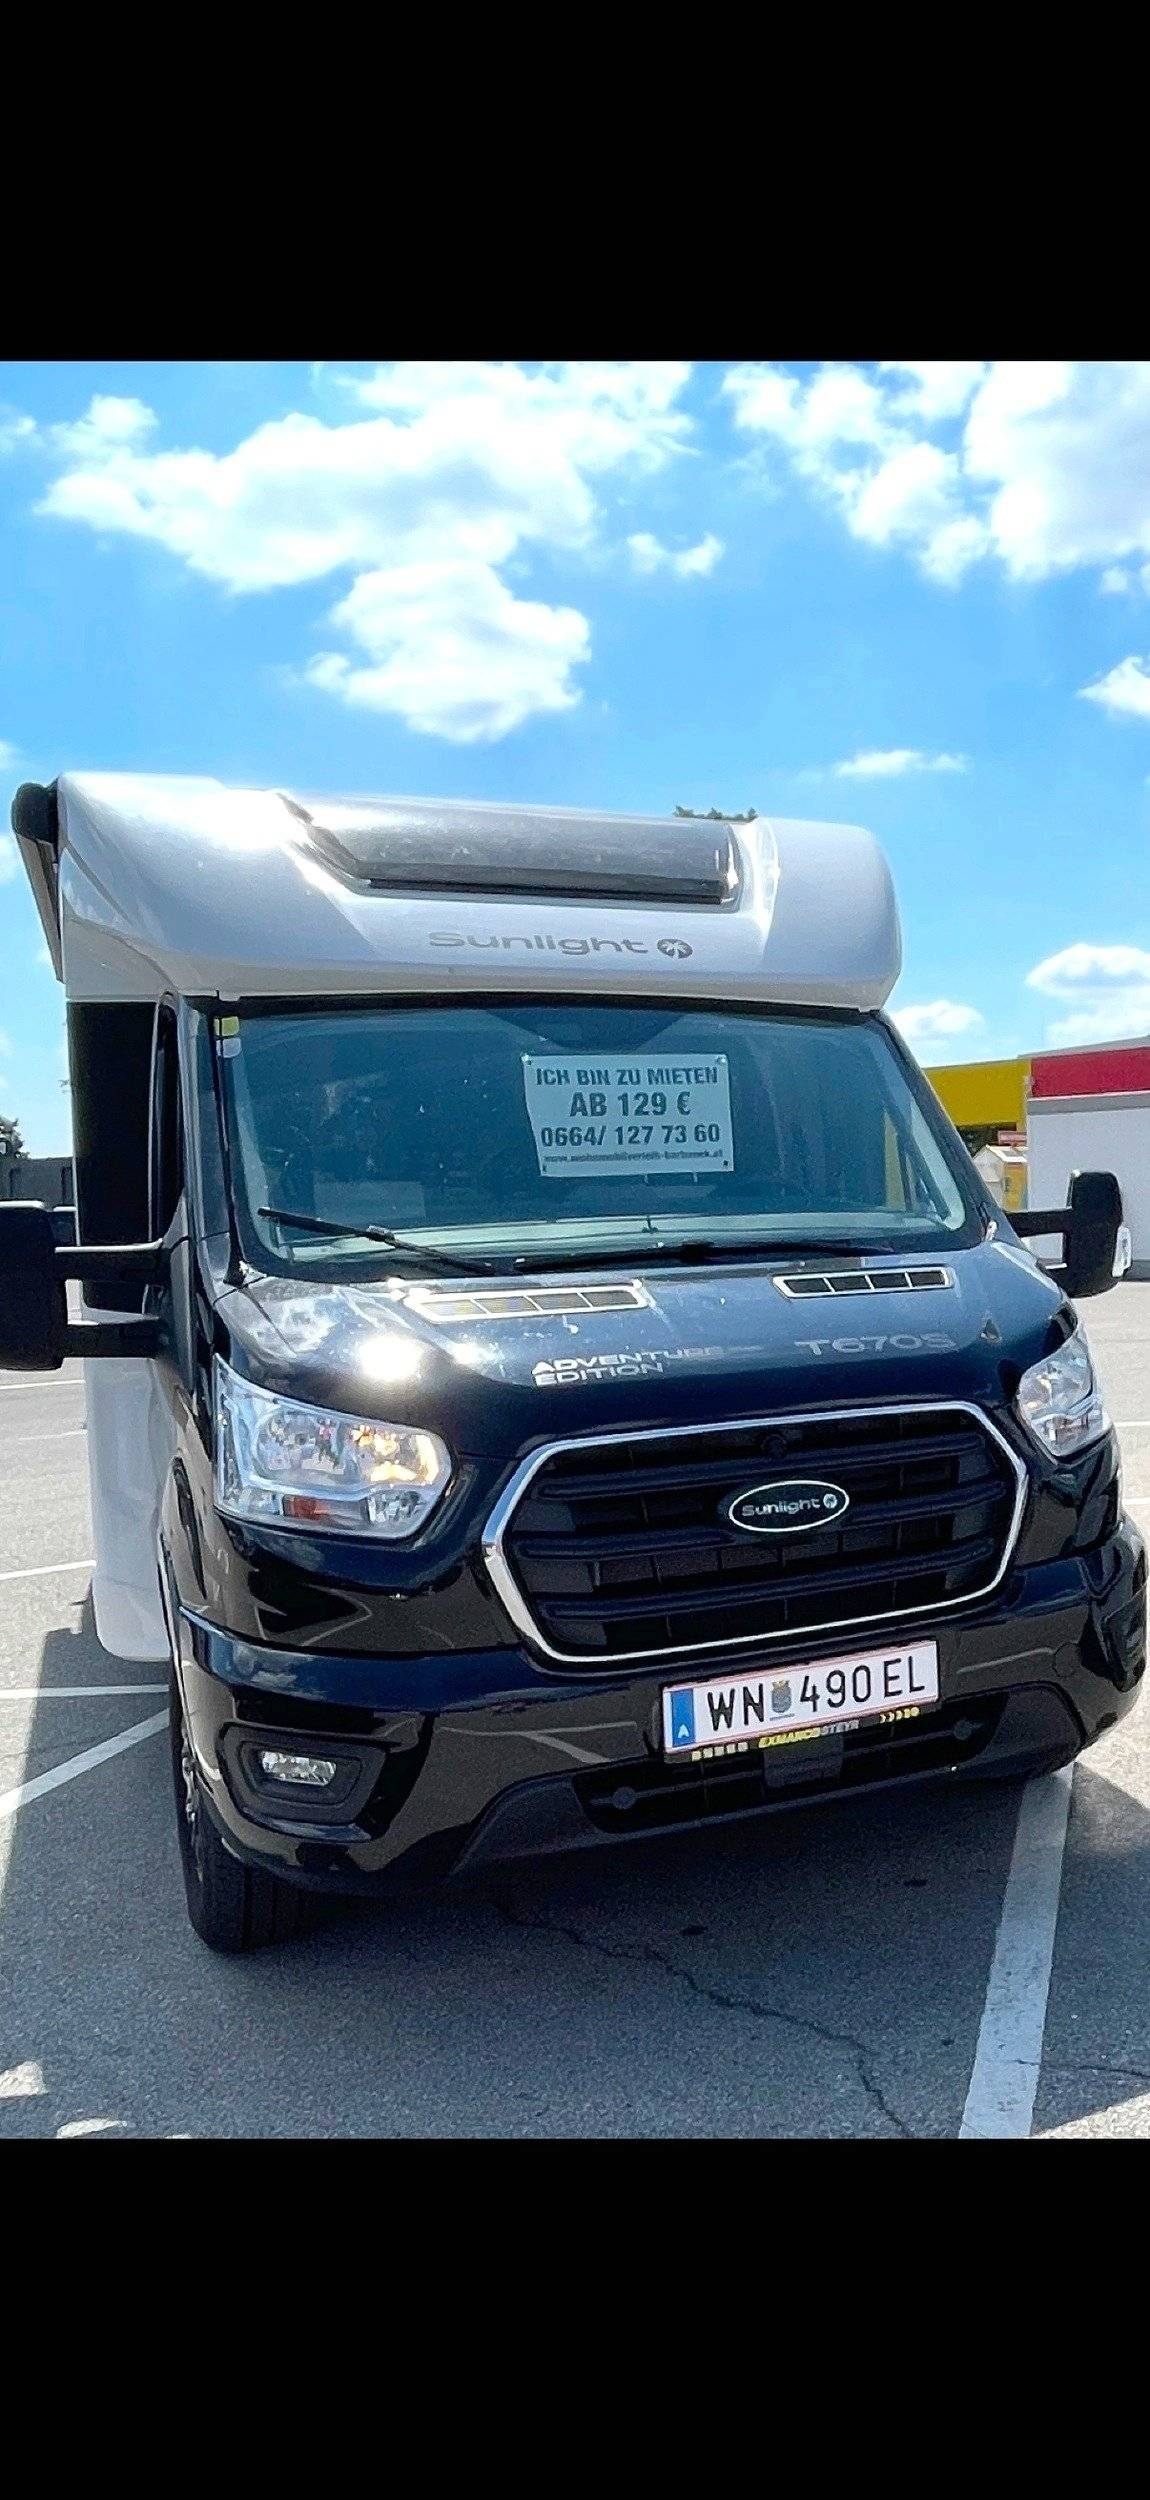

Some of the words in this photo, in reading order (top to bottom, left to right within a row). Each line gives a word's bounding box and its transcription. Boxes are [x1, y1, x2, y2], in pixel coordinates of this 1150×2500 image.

[428, 931, 649, 956] Sunlight
[536, 1068, 570, 1086] ICH
[576, 1068, 611, 1086] BIN
[616, 1068, 641, 1086] ZU
[647, 1066, 718, 1086] MIETEN
[569, 1091, 607, 1117] AB
[617, 1091, 667, 1117] 129
[676, 1091, 691, 1116] €
[540, 1125, 607, 1147] 0664/
[614, 1125, 653, 1146] 127
[661, 1124, 687, 1144] 73
[693, 1123, 720, 1143] 60
[794, 1332, 957, 1356] T670S
[534, 1362, 664, 1387] EDITION
[741, 1498, 821, 1517] Sunlight
[707, 1682, 765, 1732] WN
[800, 1665, 871, 1713] 490
[883, 1656, 926, 1698] EL
